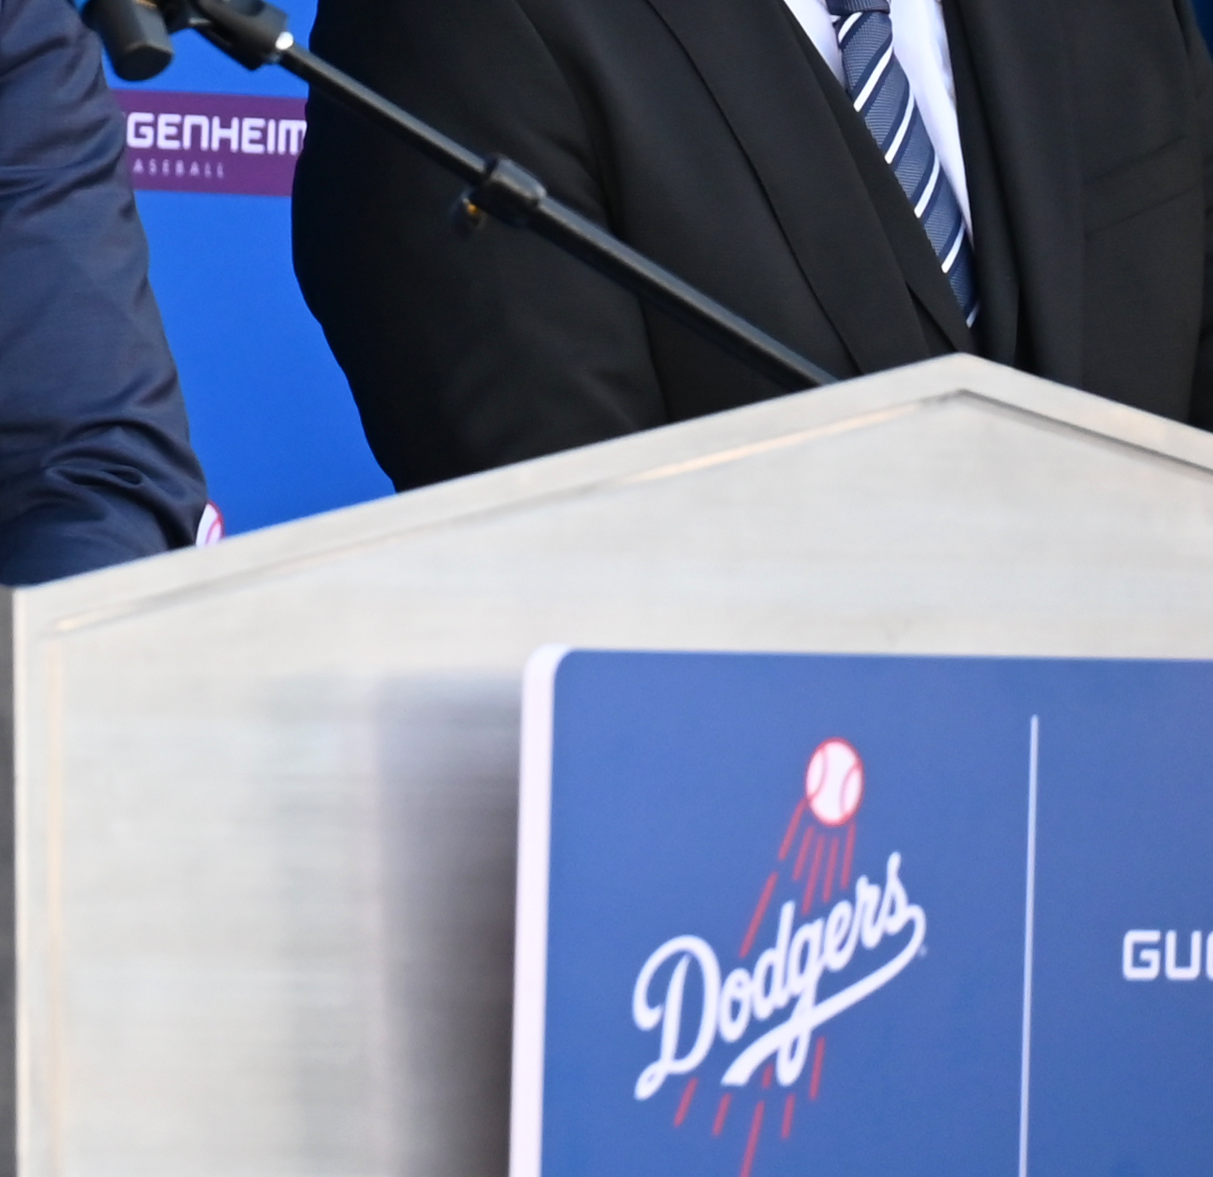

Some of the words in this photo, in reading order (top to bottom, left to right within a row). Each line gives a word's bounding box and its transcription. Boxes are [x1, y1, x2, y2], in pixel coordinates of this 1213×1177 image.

[126, 111, 308, 156] GENHEIM
[133, 158, 225, 180] ASEBALL
[633, 851, 926, 1101] Dodgers
[1122, 928, 1213, 982] GU
